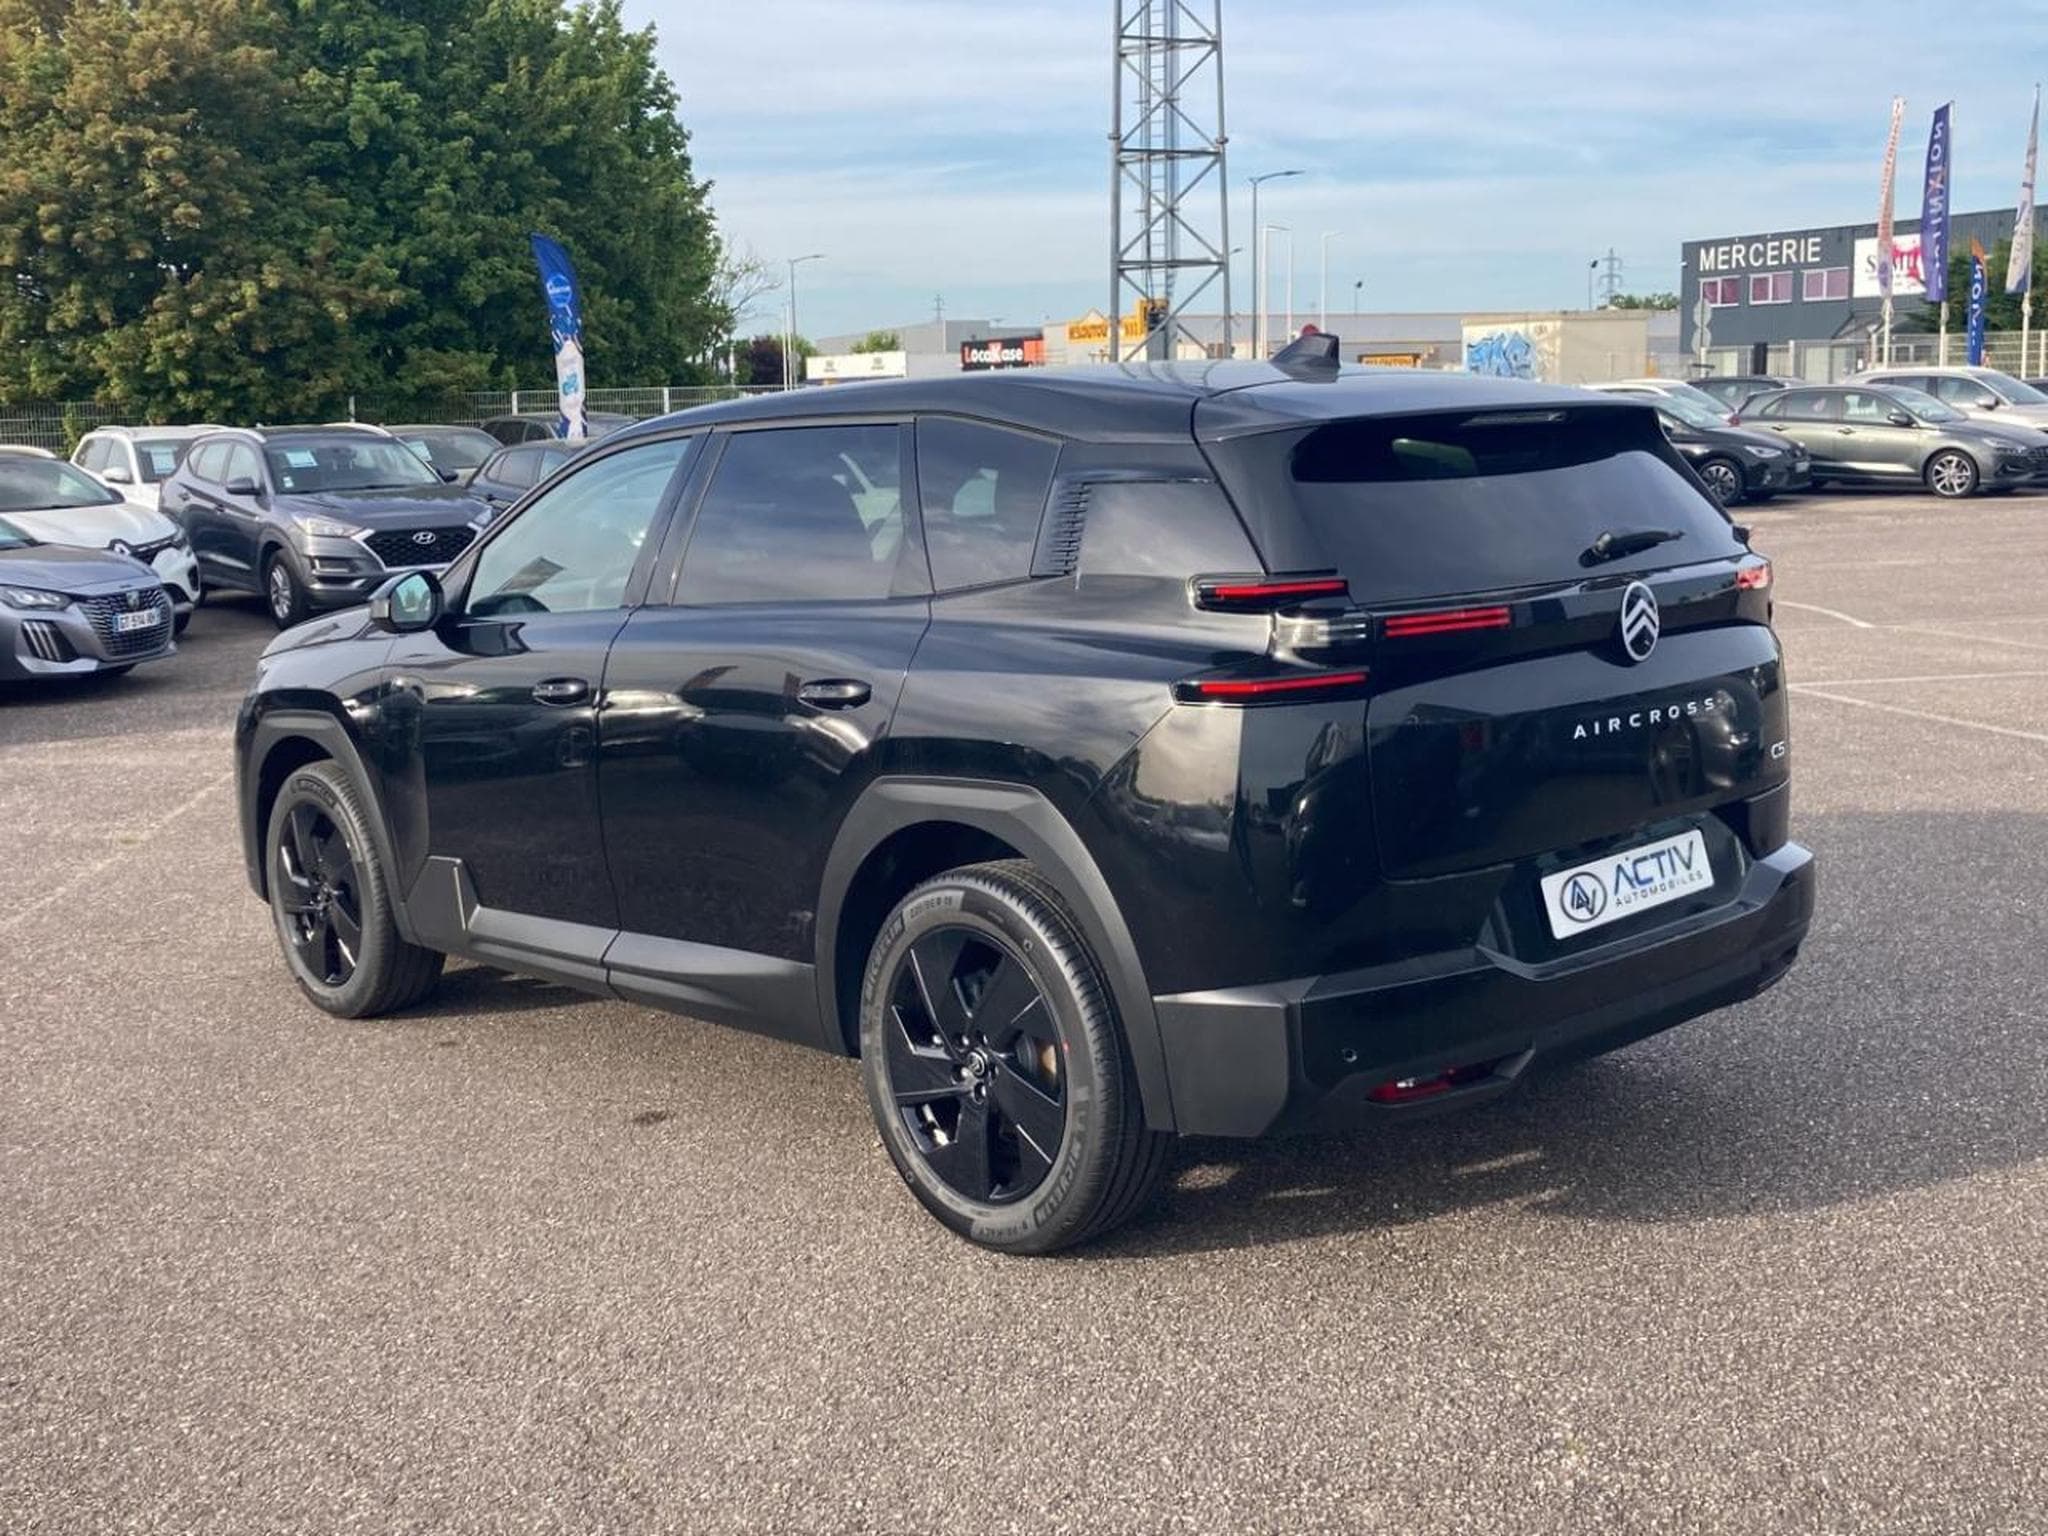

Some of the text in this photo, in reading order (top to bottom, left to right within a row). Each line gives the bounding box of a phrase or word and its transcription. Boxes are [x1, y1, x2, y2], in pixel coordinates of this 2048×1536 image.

[1699, 238, 1821, 271] MERCERIE
[1573, 698, 1715, 739] AIRCROSS
[1770, 741, 1785, 759] C5
[1614, 840, 1694, 896] ACTIV
[1615, 870, 1704, 908] AUTOMOBILES
